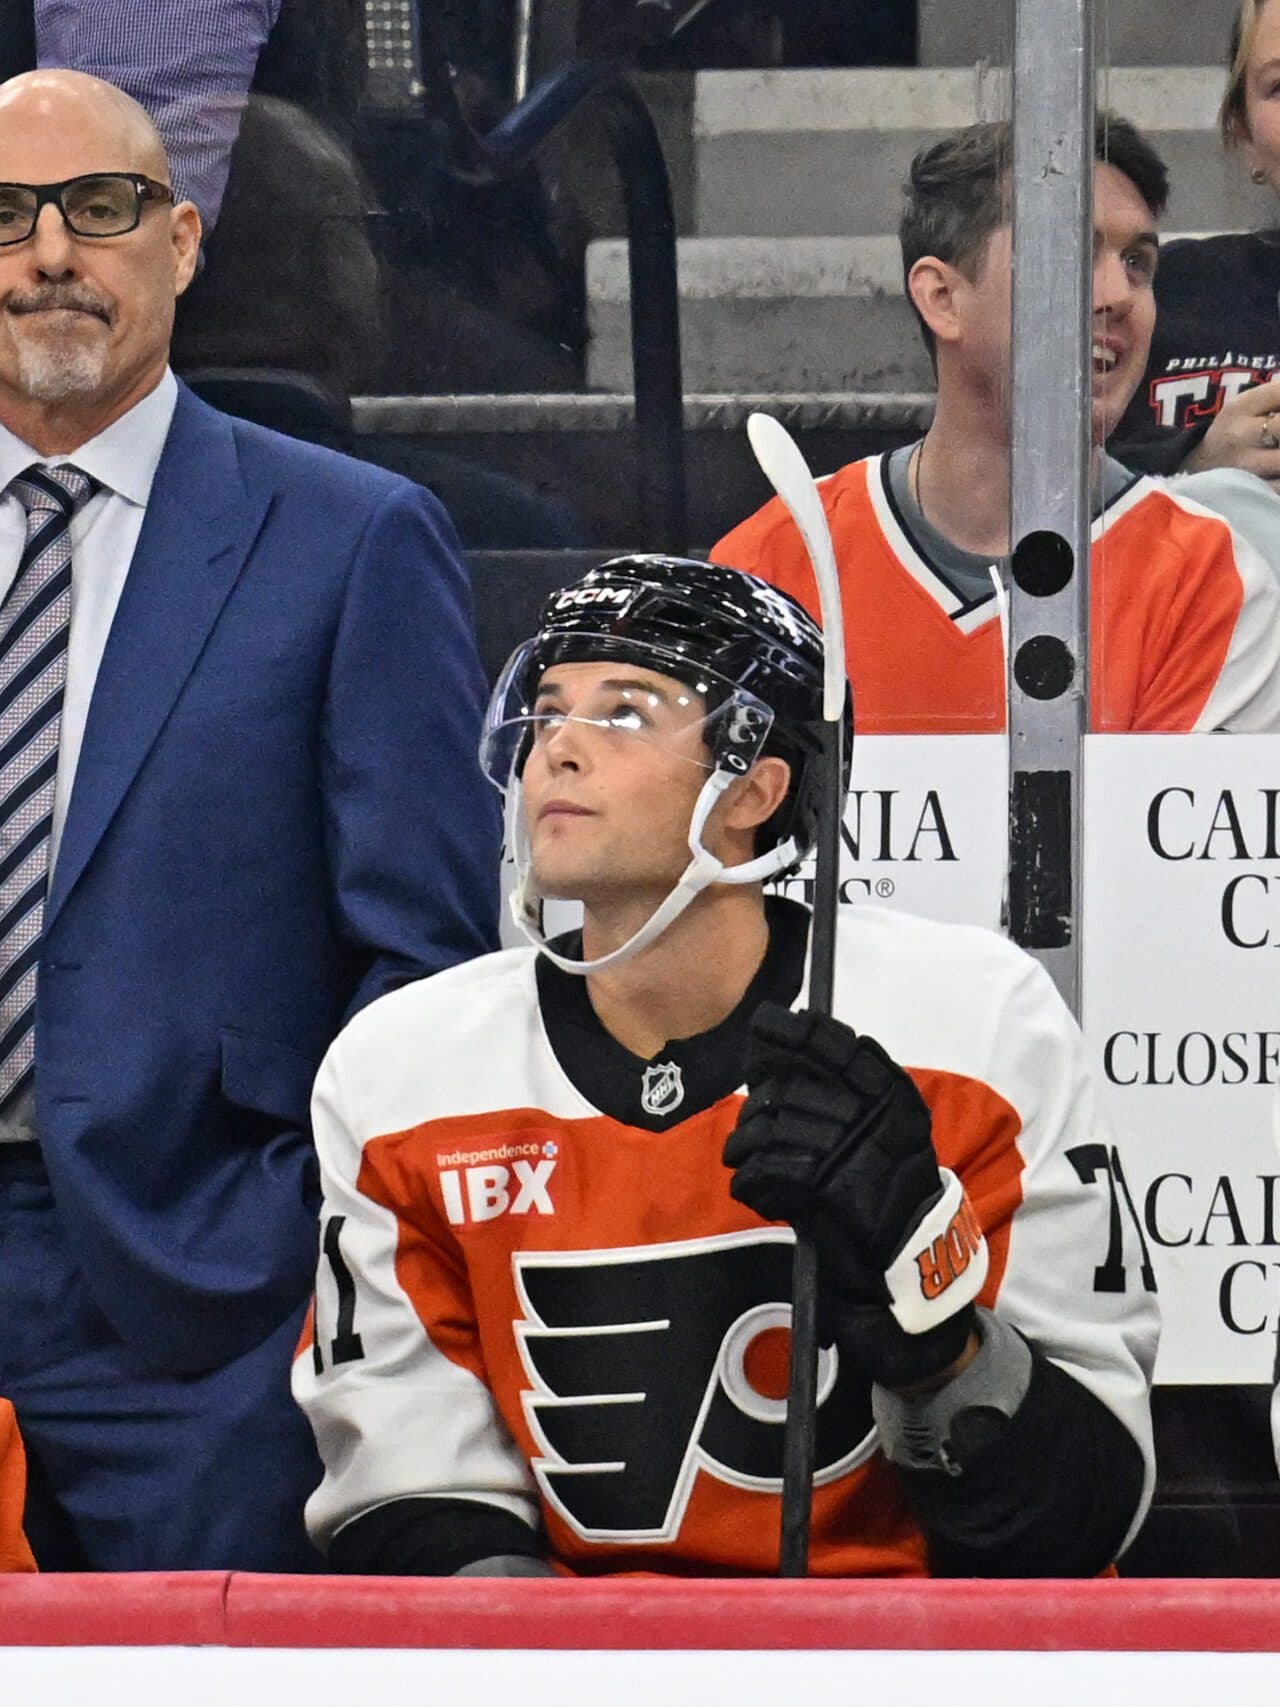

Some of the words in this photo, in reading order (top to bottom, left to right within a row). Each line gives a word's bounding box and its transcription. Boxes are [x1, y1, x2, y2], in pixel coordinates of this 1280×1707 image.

[555, 587, 632, 609] CCM
[436, 1143, 540, 1167] Independence
[439, 1159, 557, 1225] IBX
